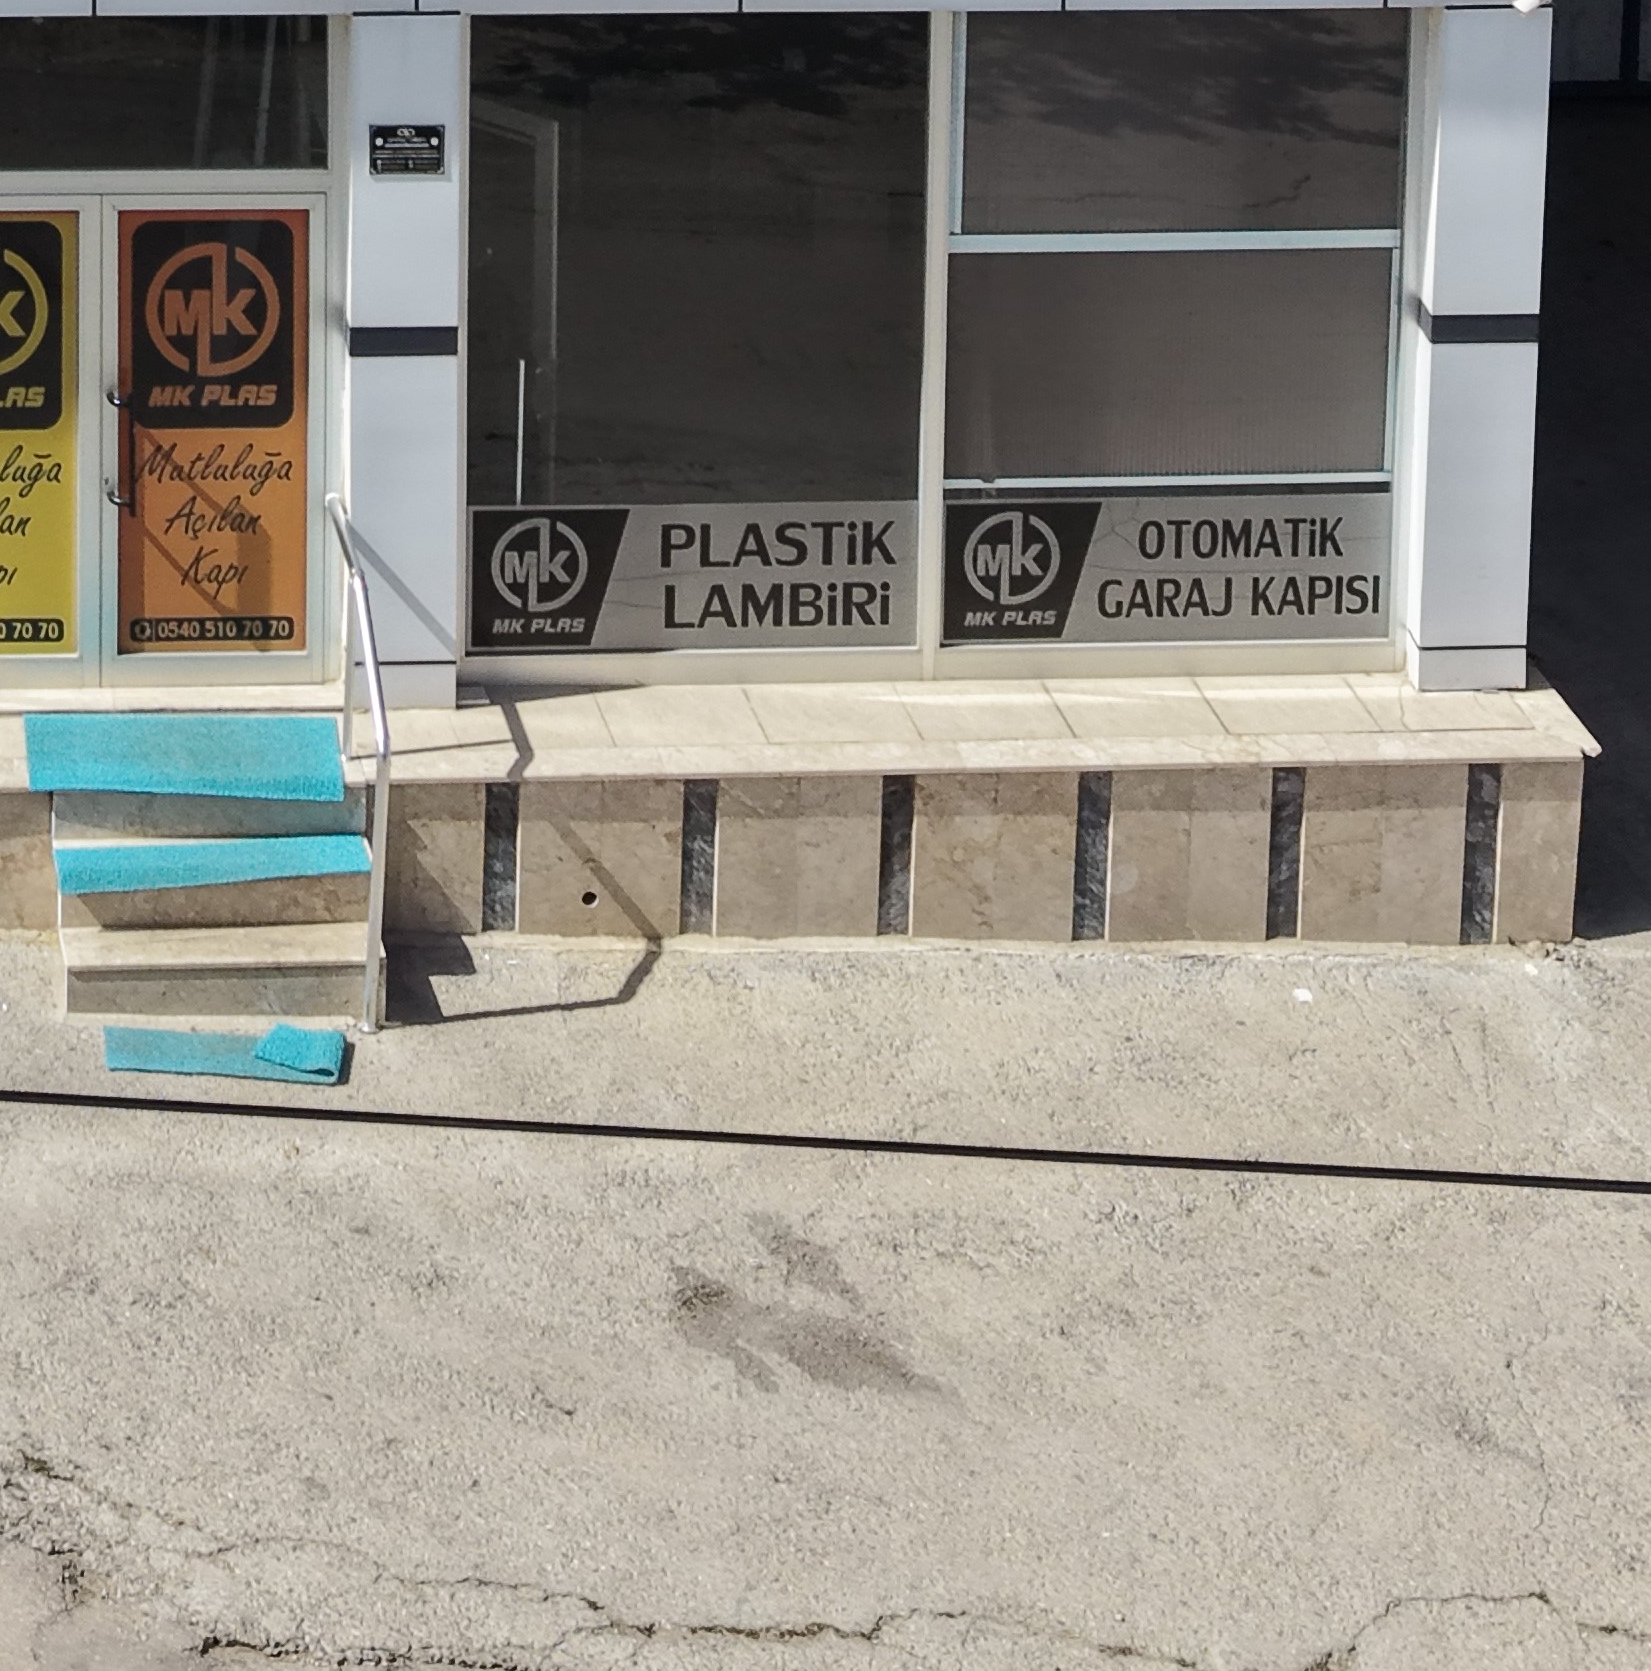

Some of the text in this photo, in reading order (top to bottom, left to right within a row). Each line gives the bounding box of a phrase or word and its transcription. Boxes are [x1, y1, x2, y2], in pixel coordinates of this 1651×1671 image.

[148, 385, 278, 408] MK PLAS
[164, 495, 261, 541] Açılan
[181, 546, 249, 601] Kapı
[1097, 573, 1381, 620] GARAJ KAPISI
[492, 617, 586, 634] MK PLAS
[963, 610, 1057, 627] MK PLAS
[12, 621, 34, 638] 70
[37, 621, 59, 638] 70
[158, 620, 290, 639] 0540 510 70 70
